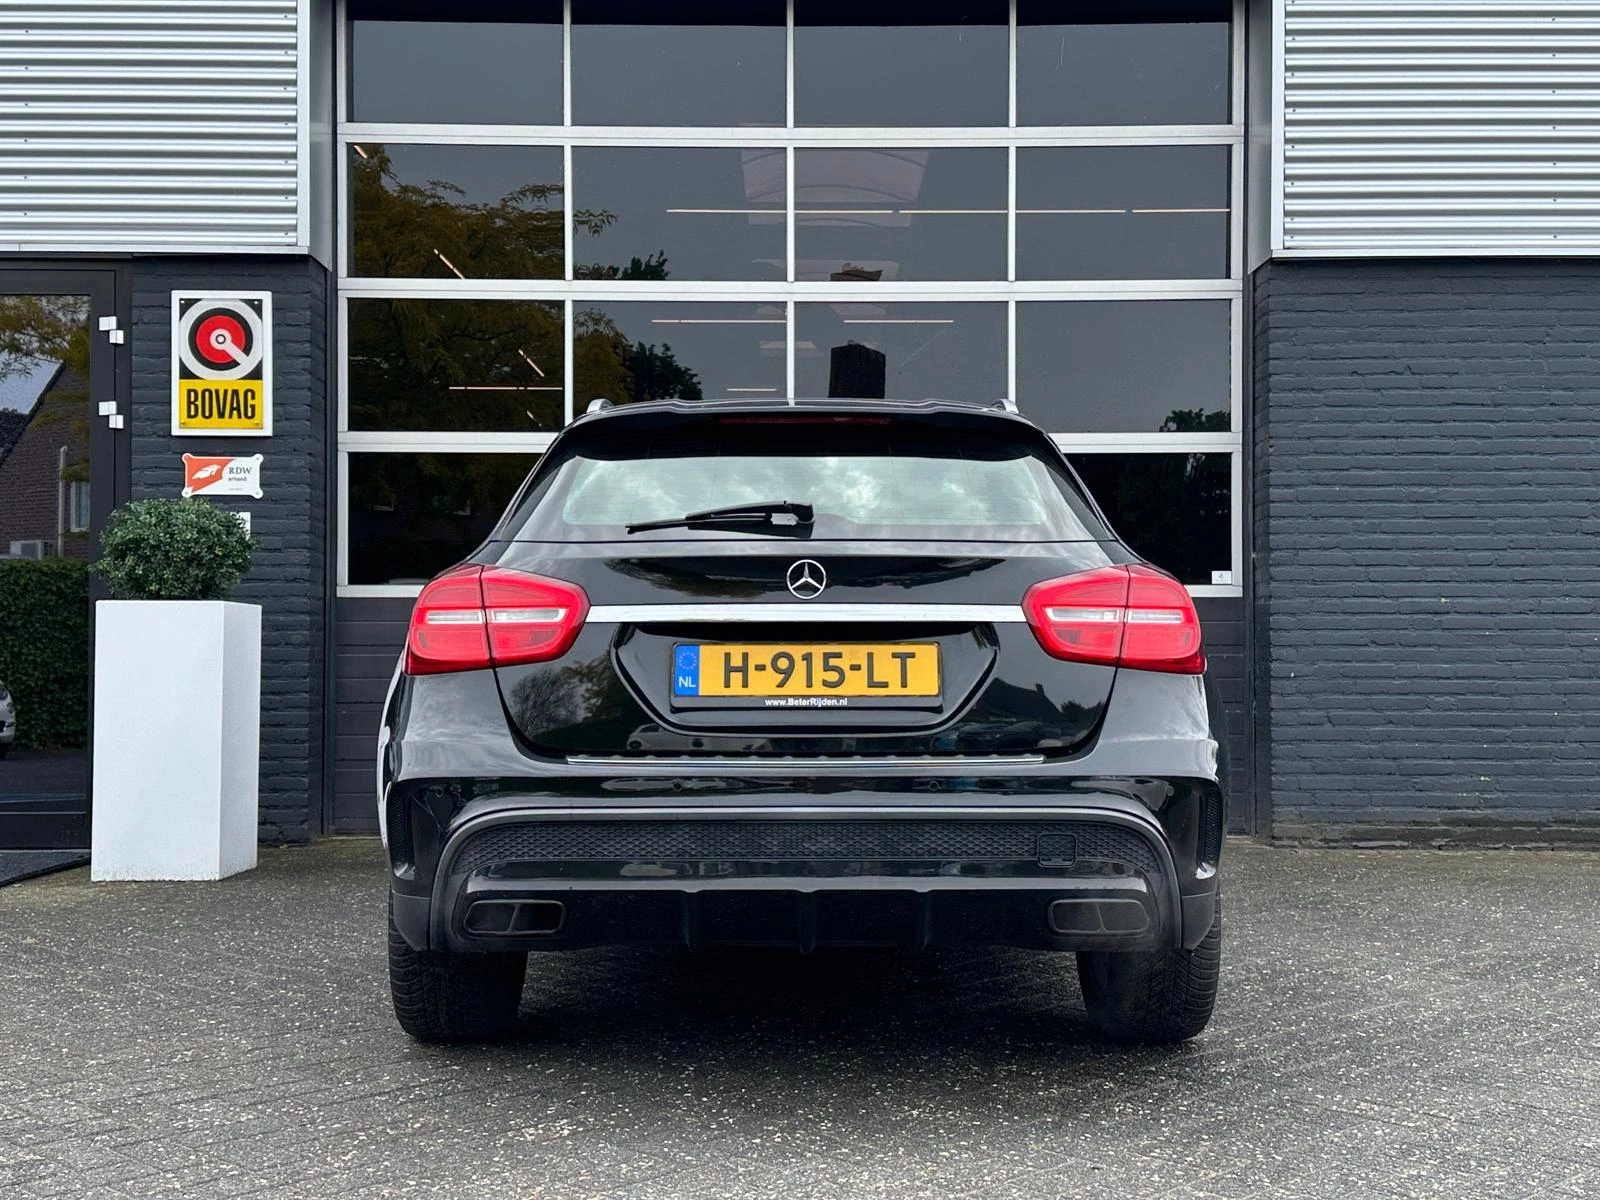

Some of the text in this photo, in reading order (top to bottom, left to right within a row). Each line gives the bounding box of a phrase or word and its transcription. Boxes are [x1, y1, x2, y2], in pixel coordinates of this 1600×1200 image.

[186, 388, 256, 419] BOVAG
[228, 466, 252, 475] RDW
[678, 651, 916, 689] NL H-915-LT
[764, 697, 848, 708] www.BeterRijden.nl
